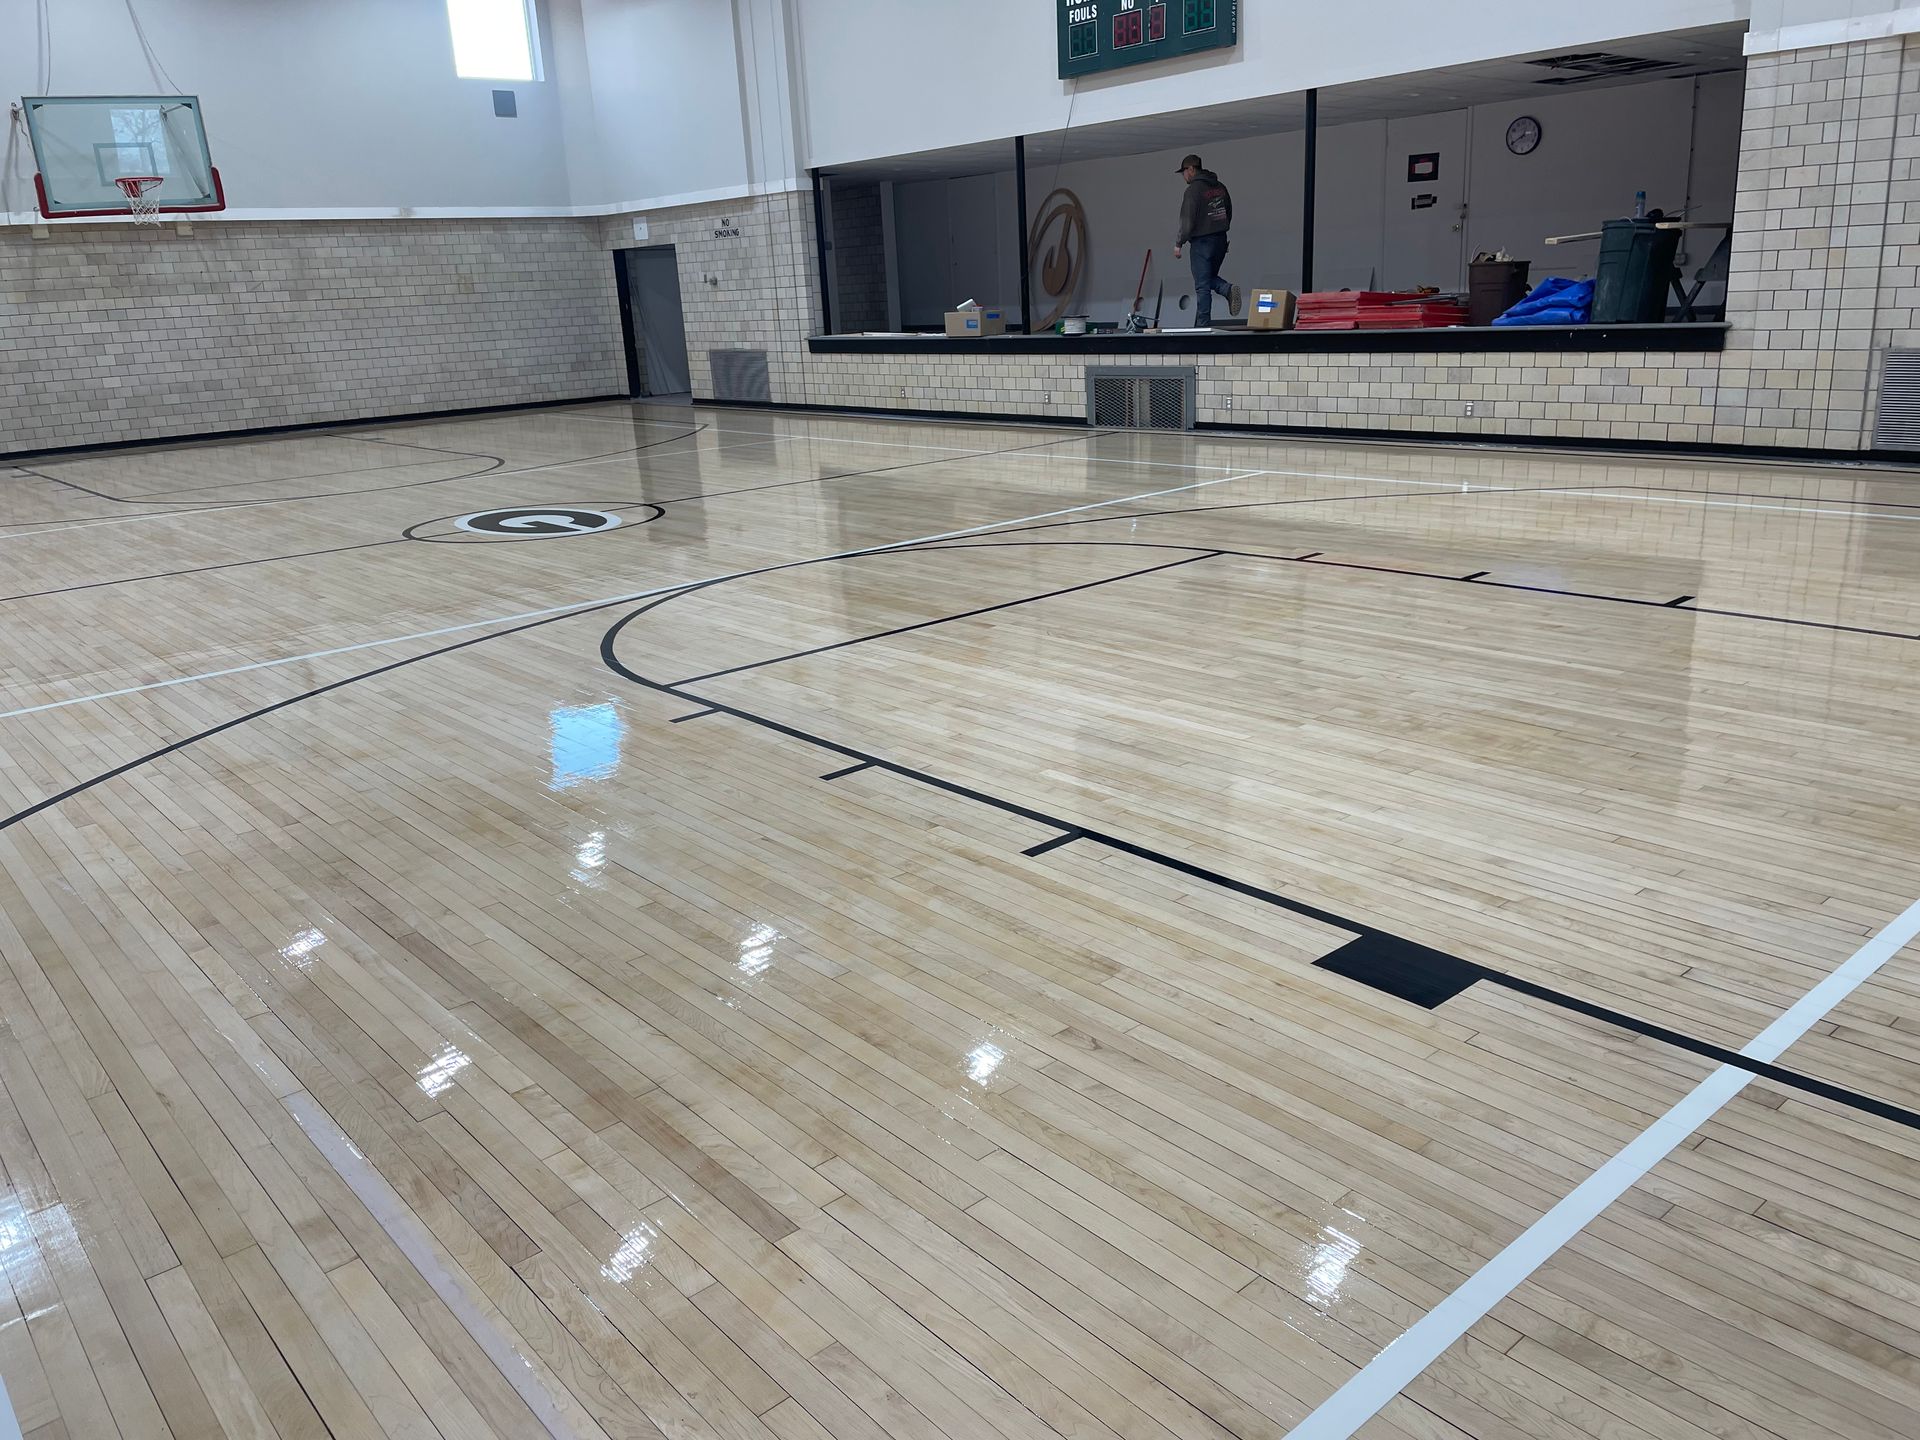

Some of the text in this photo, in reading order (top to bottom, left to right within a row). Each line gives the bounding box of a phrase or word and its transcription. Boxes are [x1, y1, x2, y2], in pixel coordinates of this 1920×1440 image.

[1069, 4, 1098, 23] FOULS
[721, 218, 730, 227] NO
[714, 228, 740, 239] SMOKING
